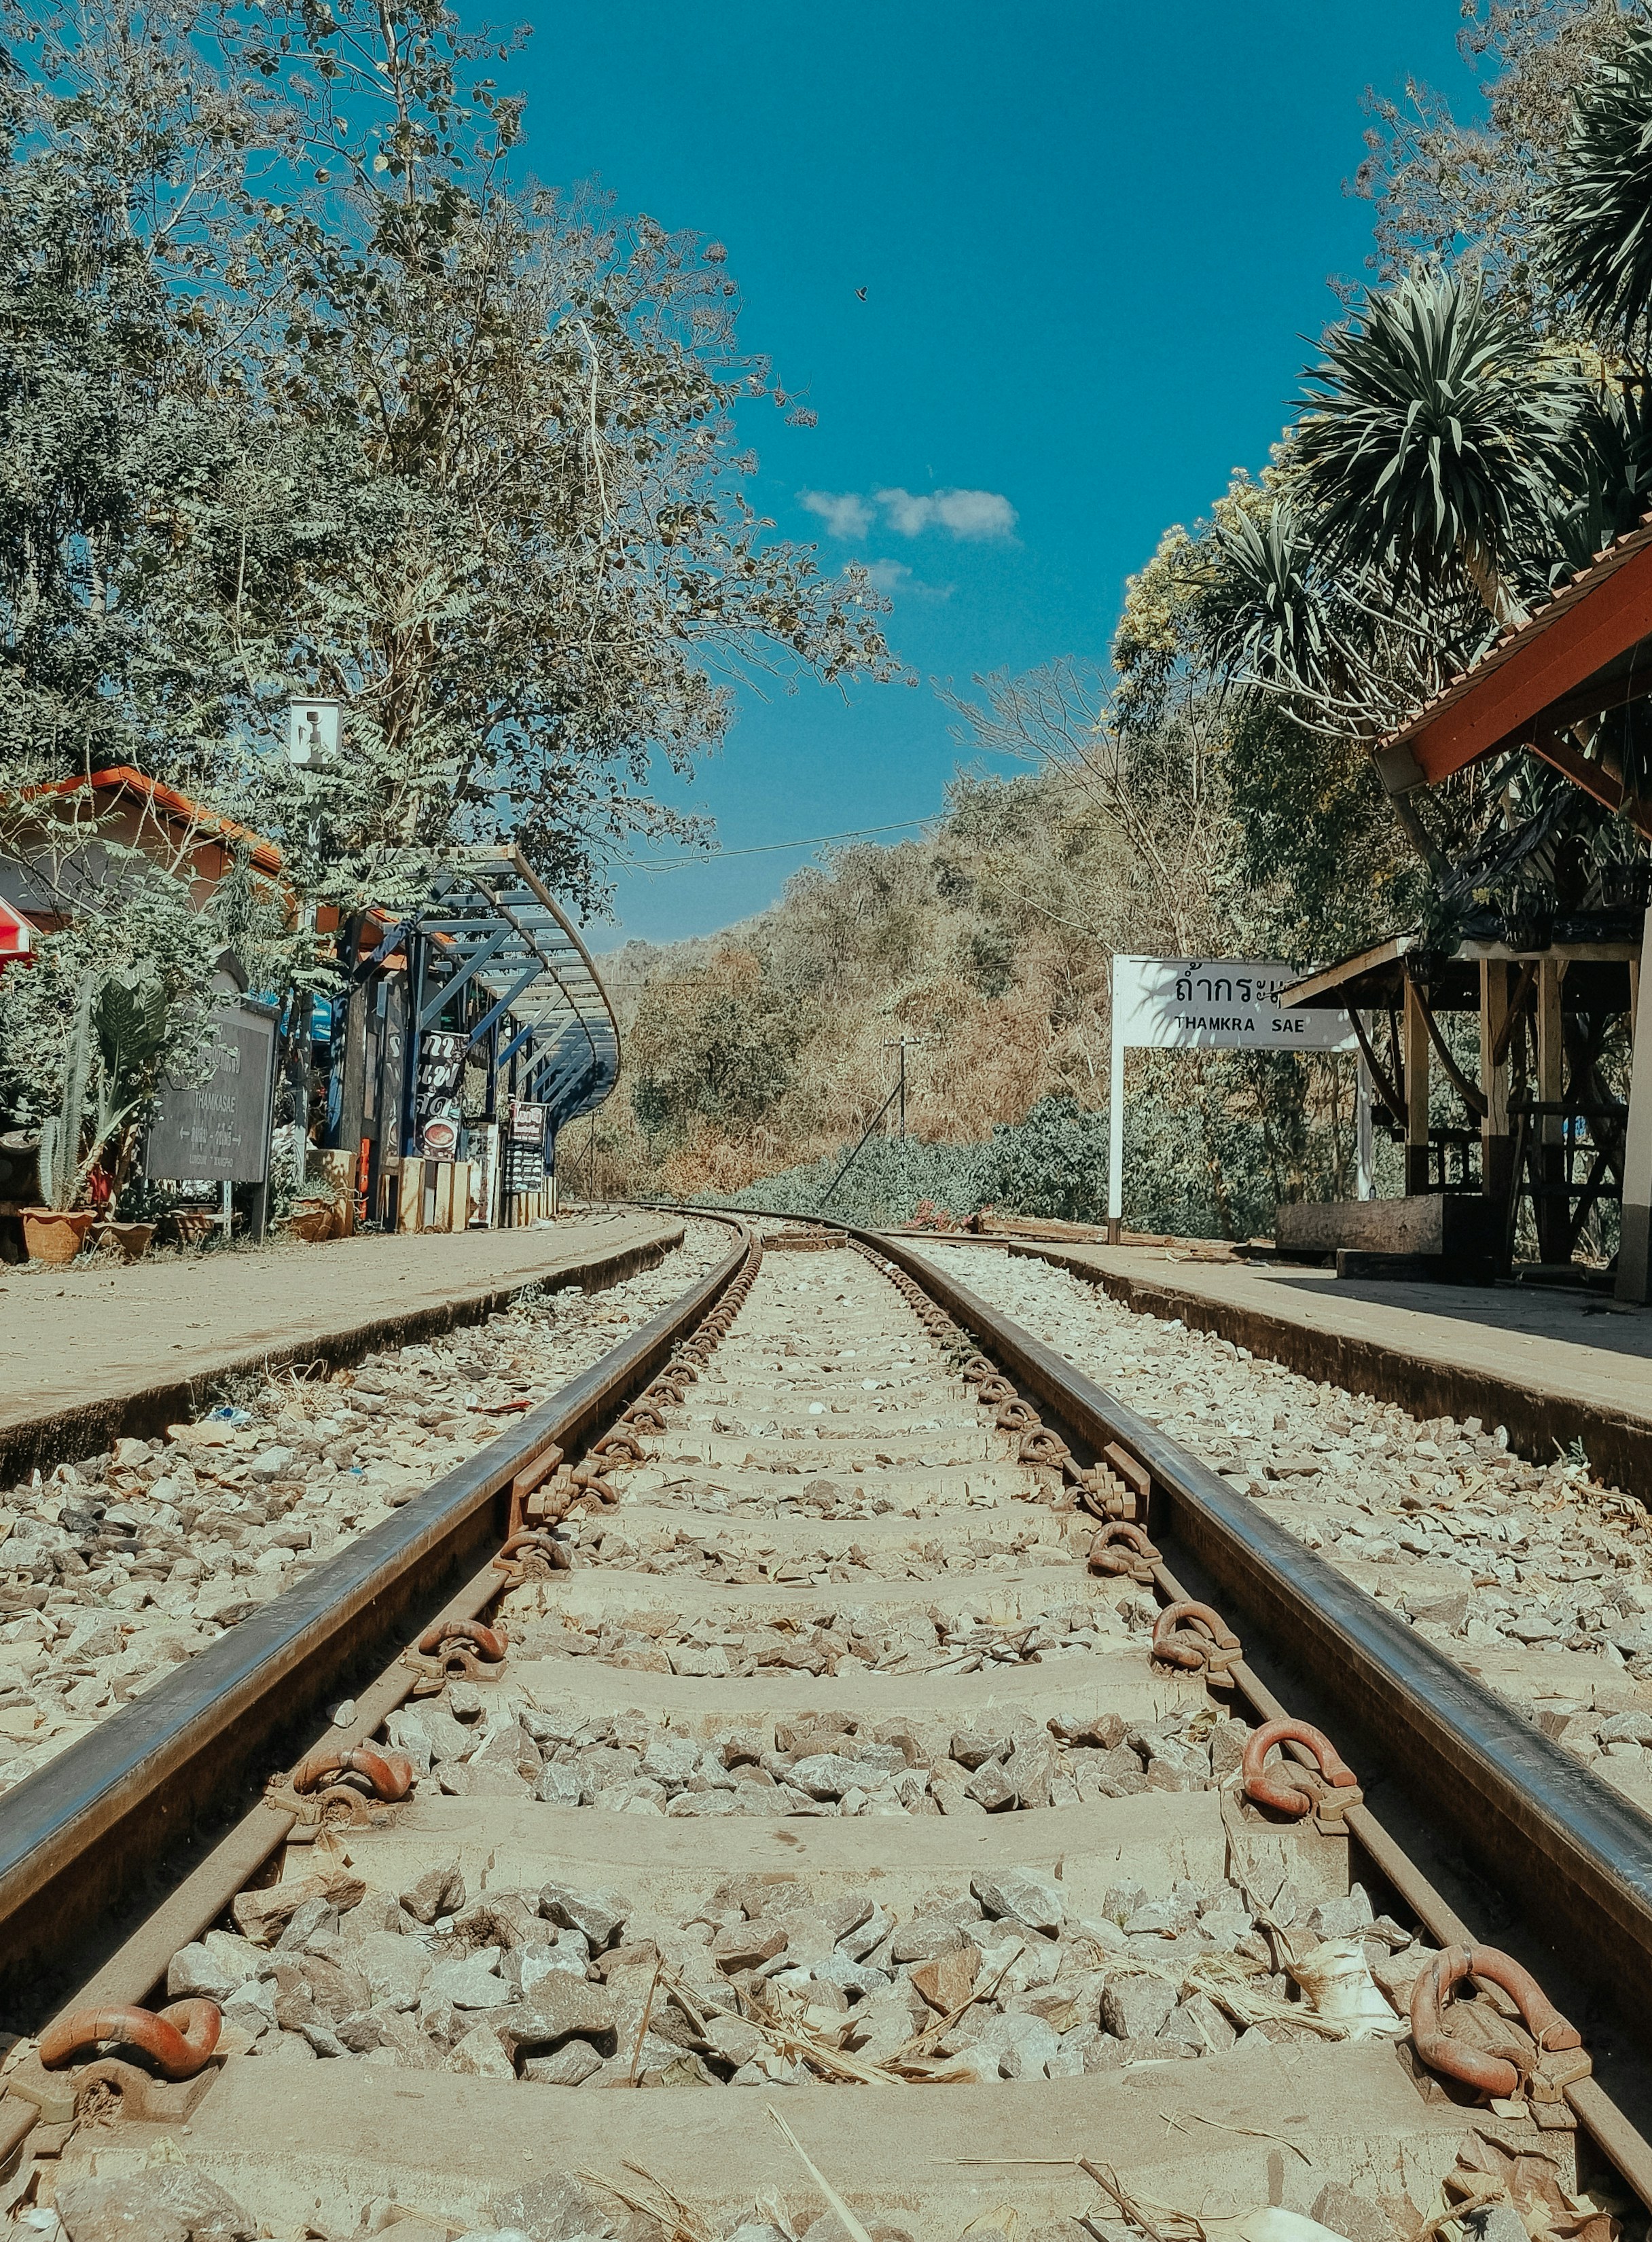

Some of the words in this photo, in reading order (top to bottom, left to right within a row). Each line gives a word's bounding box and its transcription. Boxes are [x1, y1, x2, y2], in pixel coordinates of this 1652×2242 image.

[1175, 962, 1283, 1004] ถ้ำกระแ
[1174, 1015, 1255, 1032] THAMKRA
[1272, 1019, 1304, 1033] SAE
